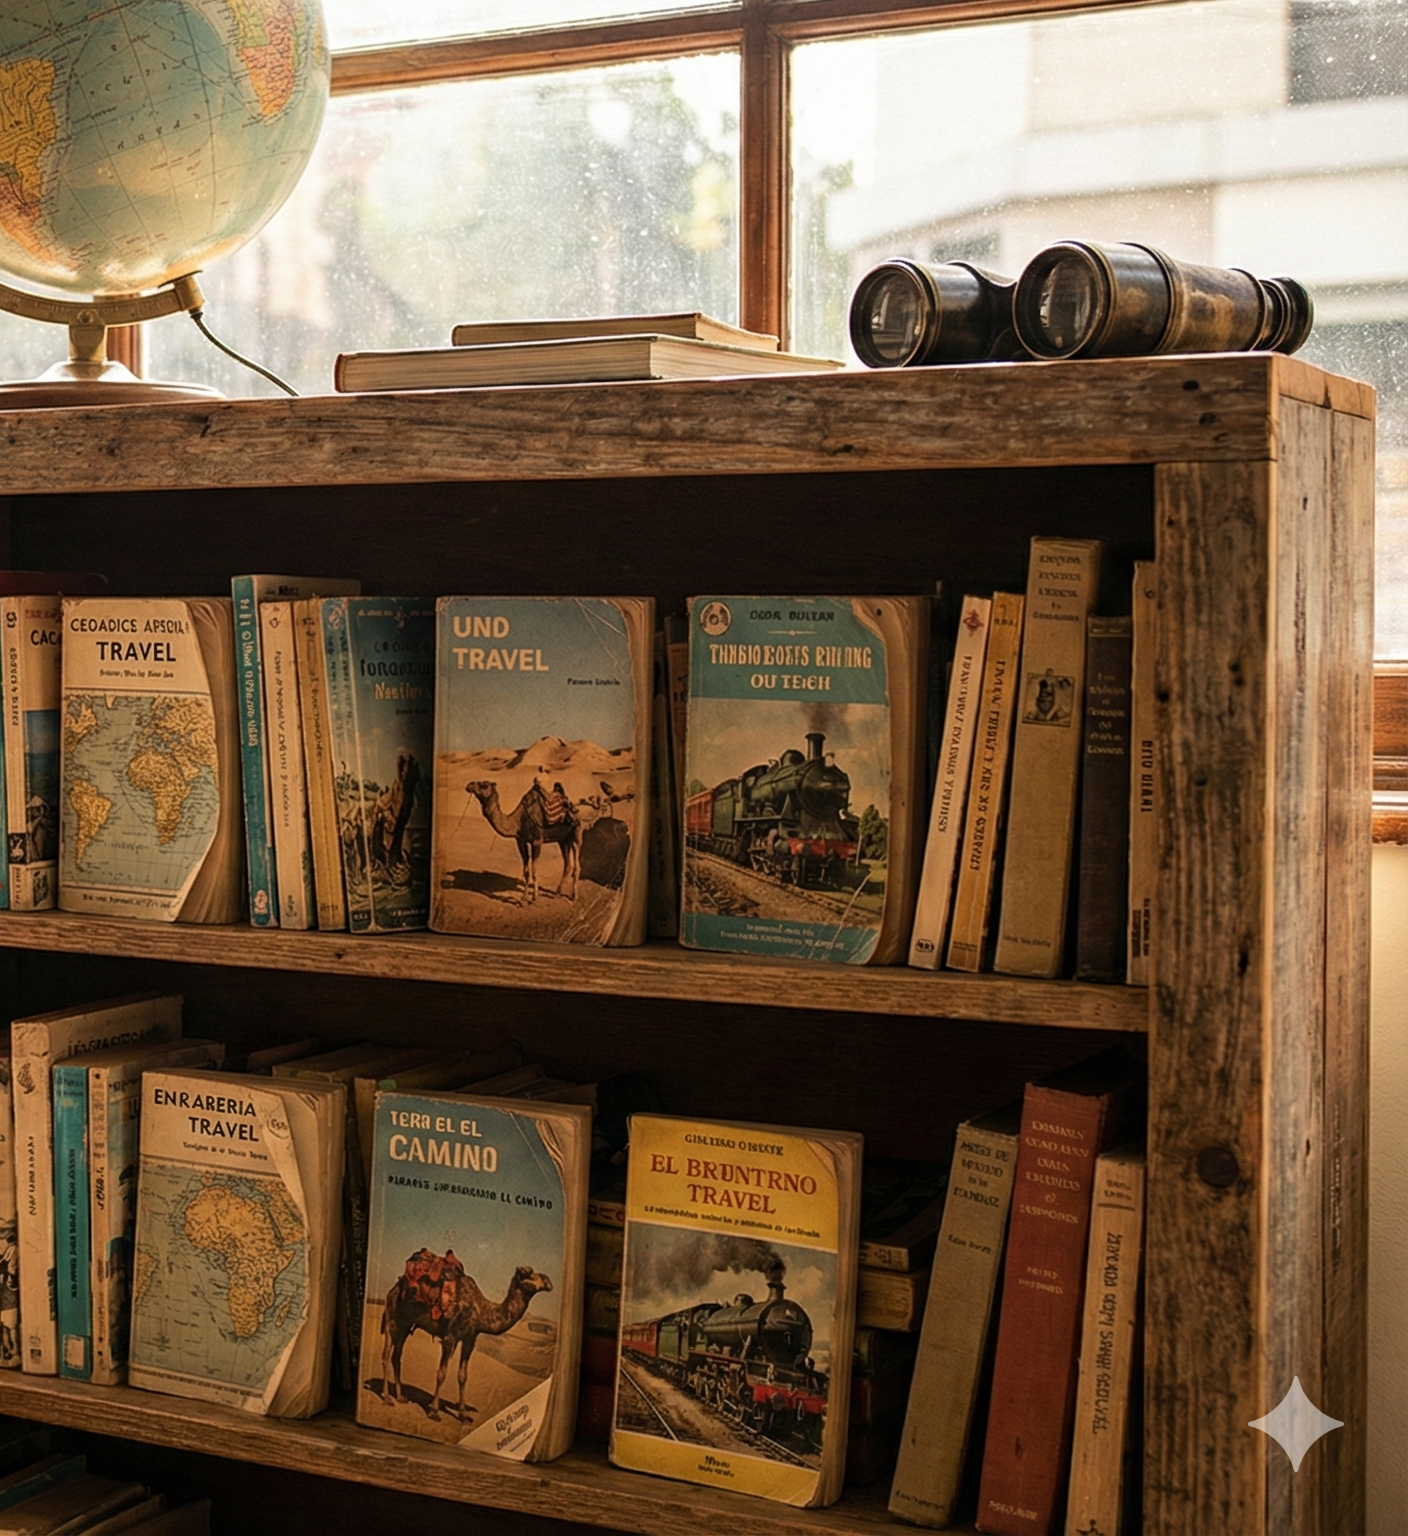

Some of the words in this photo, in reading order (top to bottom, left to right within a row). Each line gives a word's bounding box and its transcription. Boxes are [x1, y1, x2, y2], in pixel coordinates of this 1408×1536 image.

[453, 616, 510, 638] UND
[96, 641, 177, 662] TRAVEL
[452, 648, 549, 671] TRAVEL
[189, 1116, 260, 1142] TRAVEL
[435, 1117, 455, 1133] EL
[460, 1119, 482, 1138] EL
[389, 1133, 498, 1173] CAMINO
[650, 1153, 679, 1175] EL
[687, 1183, 777, 1215] TRAVEL
